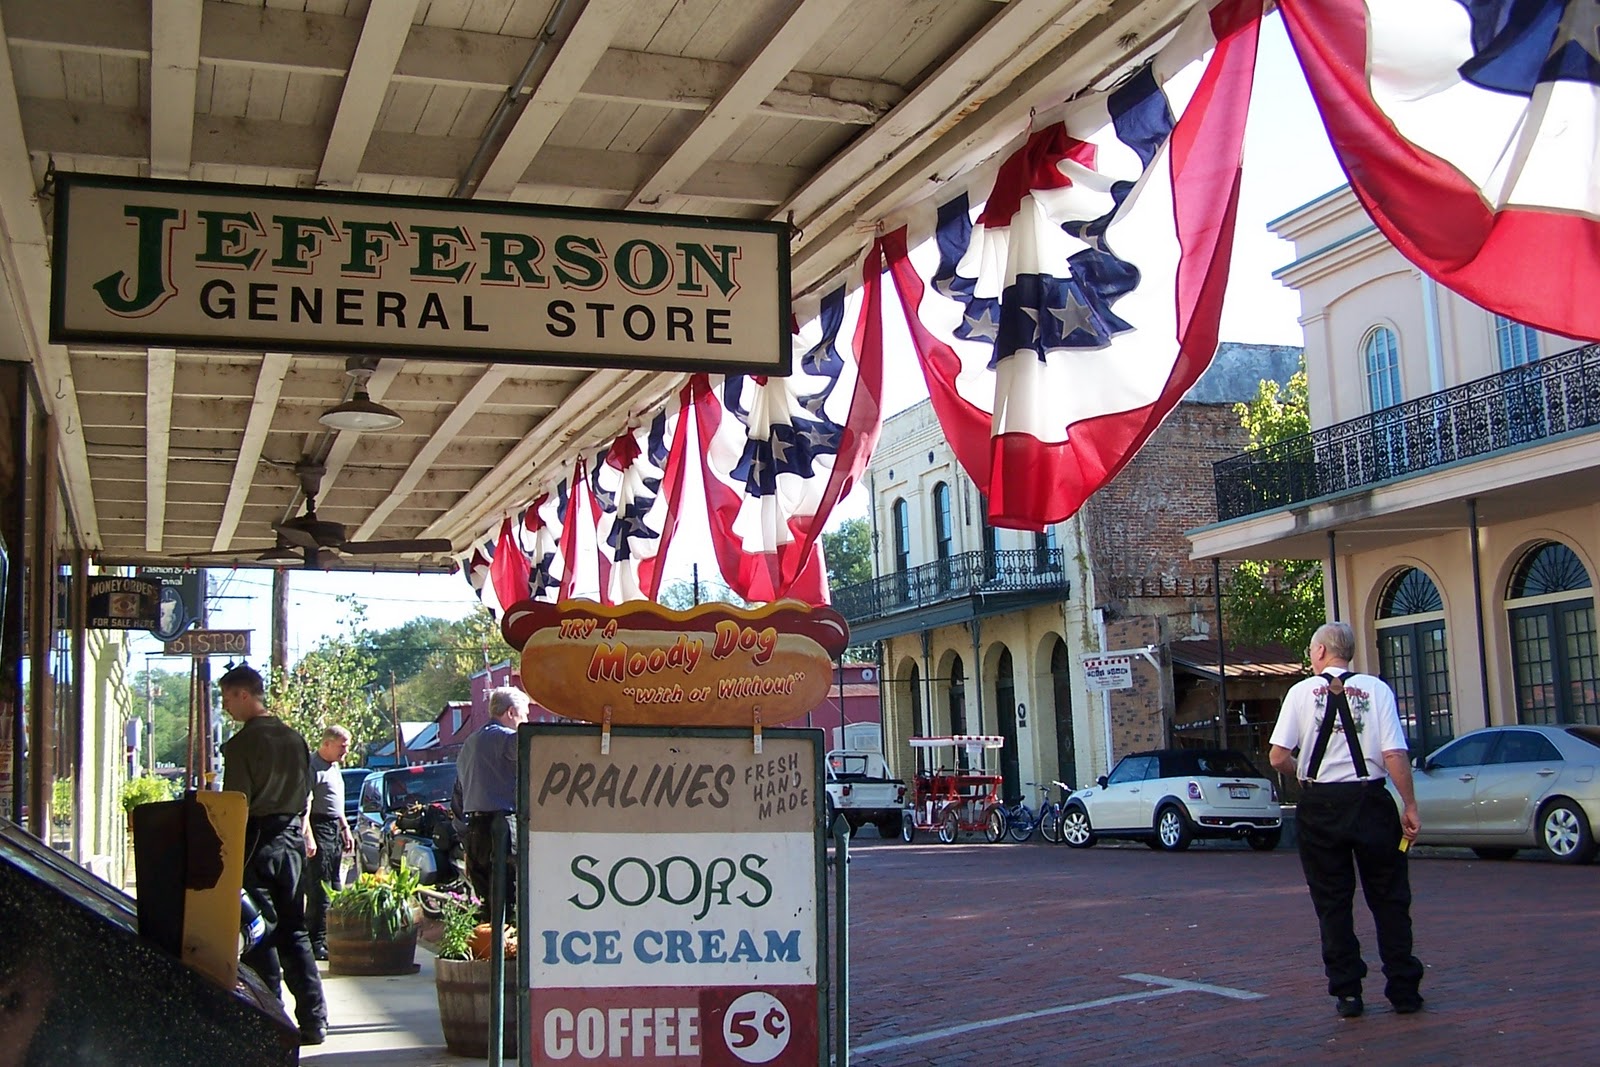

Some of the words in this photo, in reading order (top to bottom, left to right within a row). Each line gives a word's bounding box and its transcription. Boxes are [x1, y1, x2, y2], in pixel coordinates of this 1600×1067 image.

[92, 204, 743, 319] JEFFERSON
[199, 278, 490, 333] GENERAL
[545, 300, 734, 345] STORE
[91, 579, 121, 598] MONEY
[92, 617, 109, 627] FOR
[111, 617, 131, 628] SALE
[558, 617, 598, 640] TRY
[601, 617, 618, 640] A
[171, 632, 247, 654] BISTRO
[587, 633, 705, 684] Moody
[712, 619, 778, 666] Dog
[687, 687, 712, 703] or
[537, 761, 736, 809] PRALINES
[744, 752, 799, 786] FRESH
[753, 771, 802, 802] HAND
[758, 788, 809, 821] MADE
[567, 853, 773, 921] SODAS
[541, 929, 623, 965] ICE
[633, 929, 802, 963] CREAM
[543, 1007, 701, 1060] COFFEE
